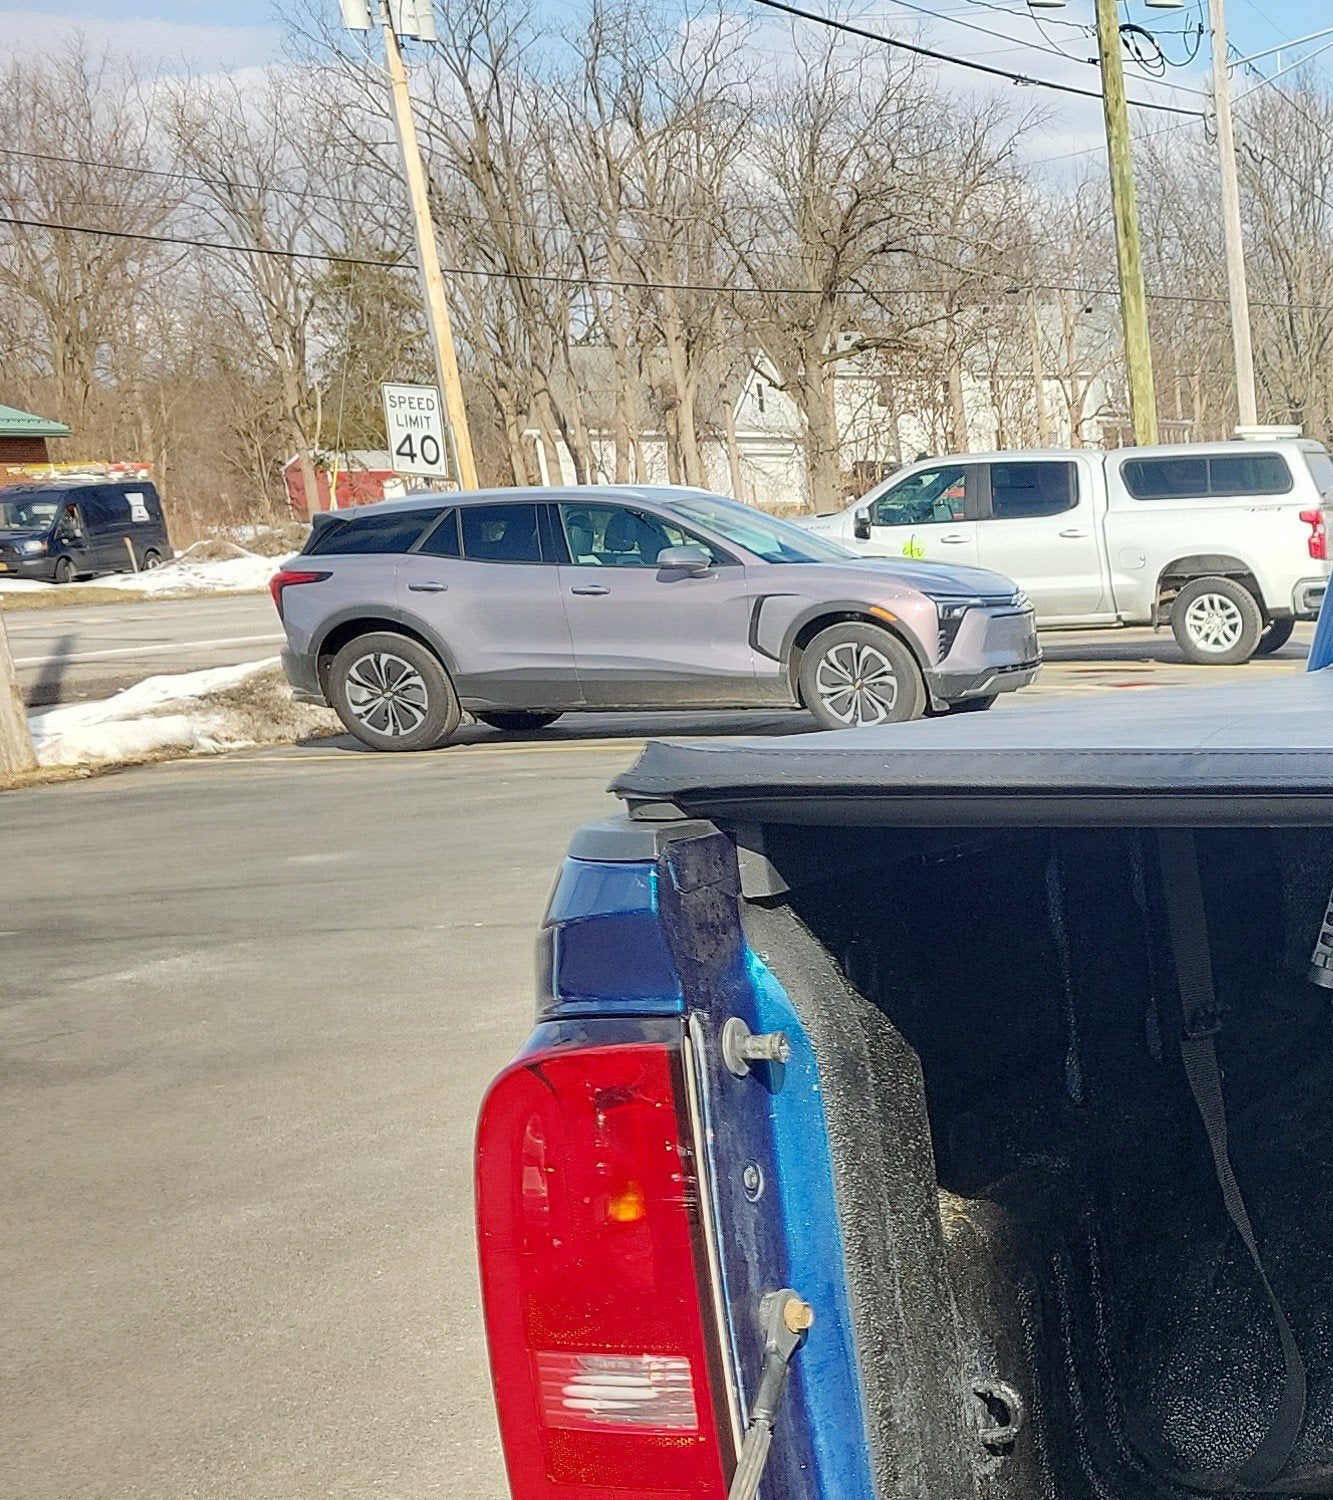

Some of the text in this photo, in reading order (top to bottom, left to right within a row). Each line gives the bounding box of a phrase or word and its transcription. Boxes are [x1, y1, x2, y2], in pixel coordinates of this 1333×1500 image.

[388, 395, 435, 411] SPEED
[396, 413, 431, 429] LIMIT
[395, 433, 440, 466] 40
